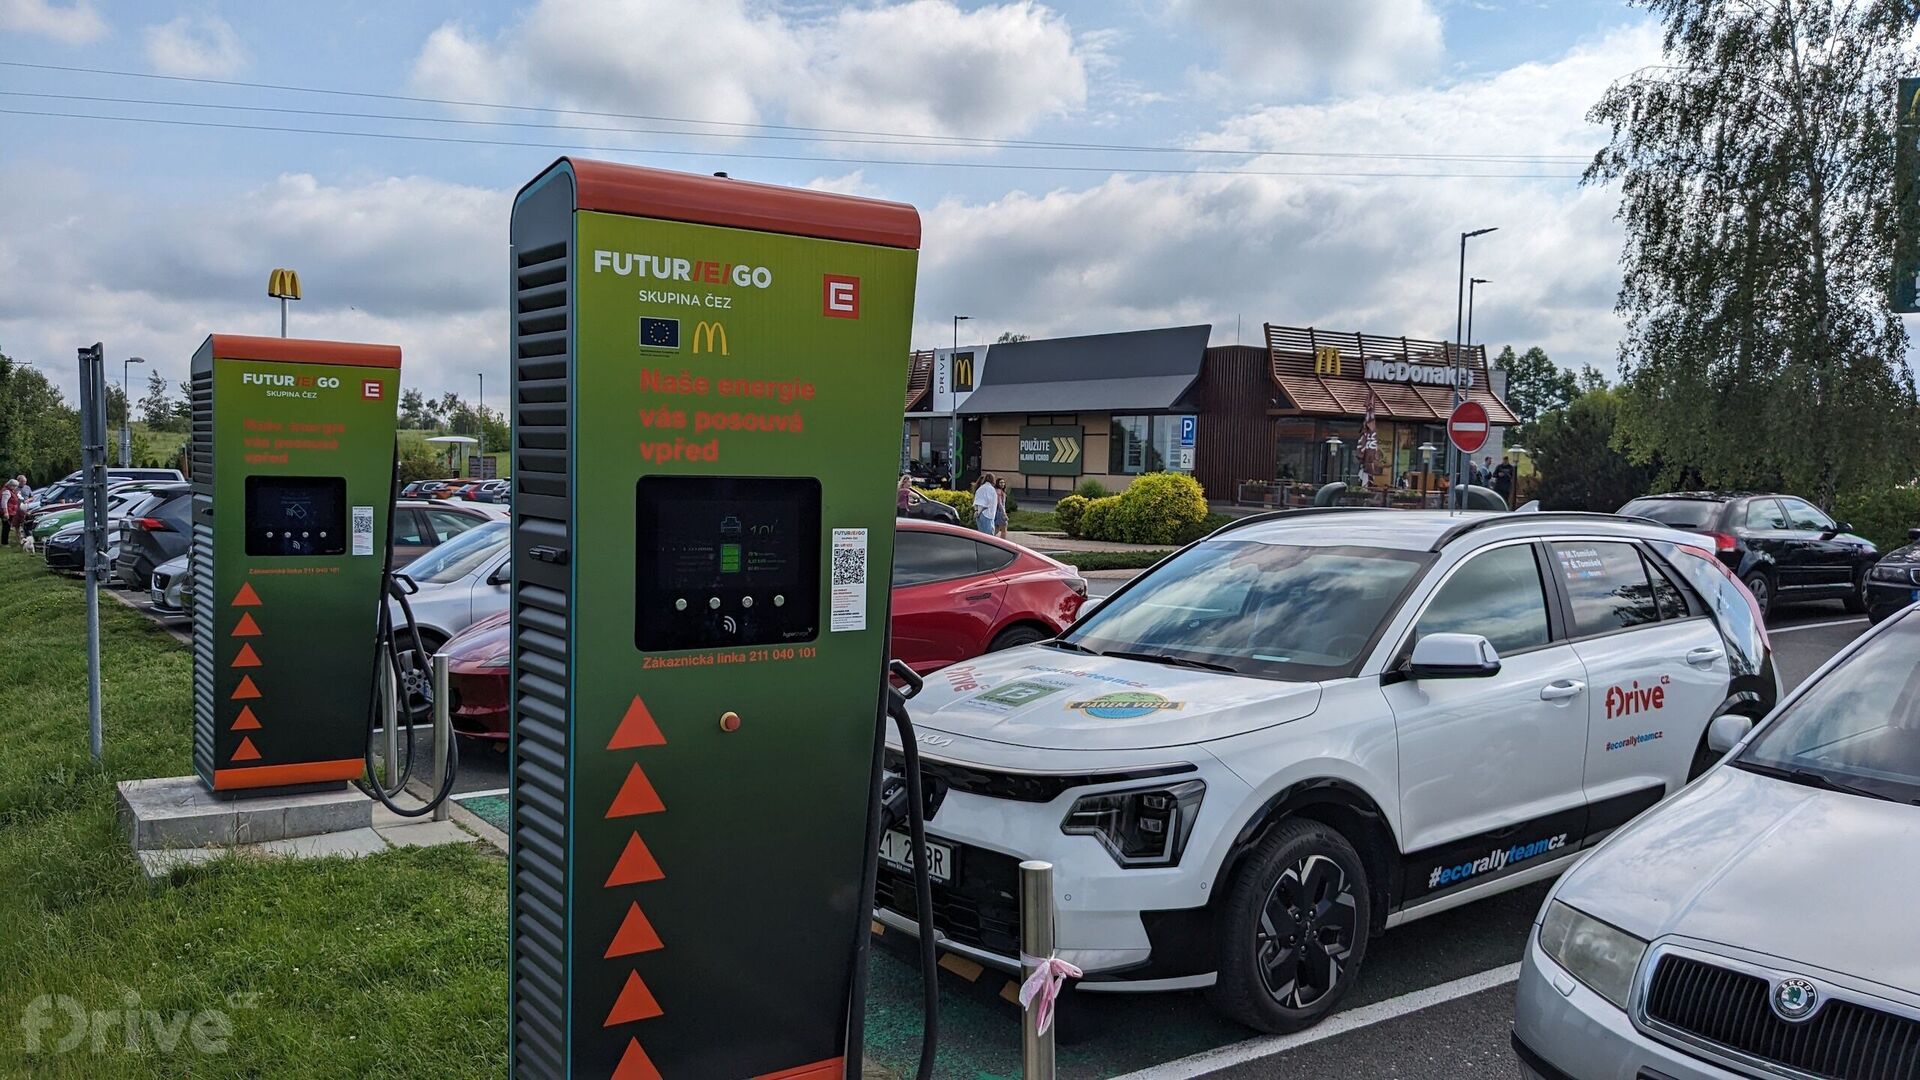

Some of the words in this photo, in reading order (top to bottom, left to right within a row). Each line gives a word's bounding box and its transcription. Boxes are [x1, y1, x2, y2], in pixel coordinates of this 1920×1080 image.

[594, 250, 772, 289] FUTUR/E/GO
[639, 290, 701, 307] SKUPINA
[704, 293, 732, 309] ČEZ
[266, 390, 300, 398] SKUPINA
[302, 391, 317, 399] ČEZ
[640, 368, 710, 396] Naše
[717, 376, 816, 404] energie
[640, 403, 687, 429] vás
[694, 409, 804, 433] posouvá
[1183, 420, 1193, 438] P
[640, 437, 719, 465] vpřed
[1020, 437, 1050, 451] POUŽIJTE
[642, 653, 714, 669] Zákaznická
[717, 651, 746, 664] linka
[750, 650, 768, 661] 211
[772, 648, 795, 660] 040
[800, 647, 817, 658] 101
[1605, 731, 1663, 752] #ecorallyteamcz
[1428, 833, 1568, 888] #ecorallyteamcz
